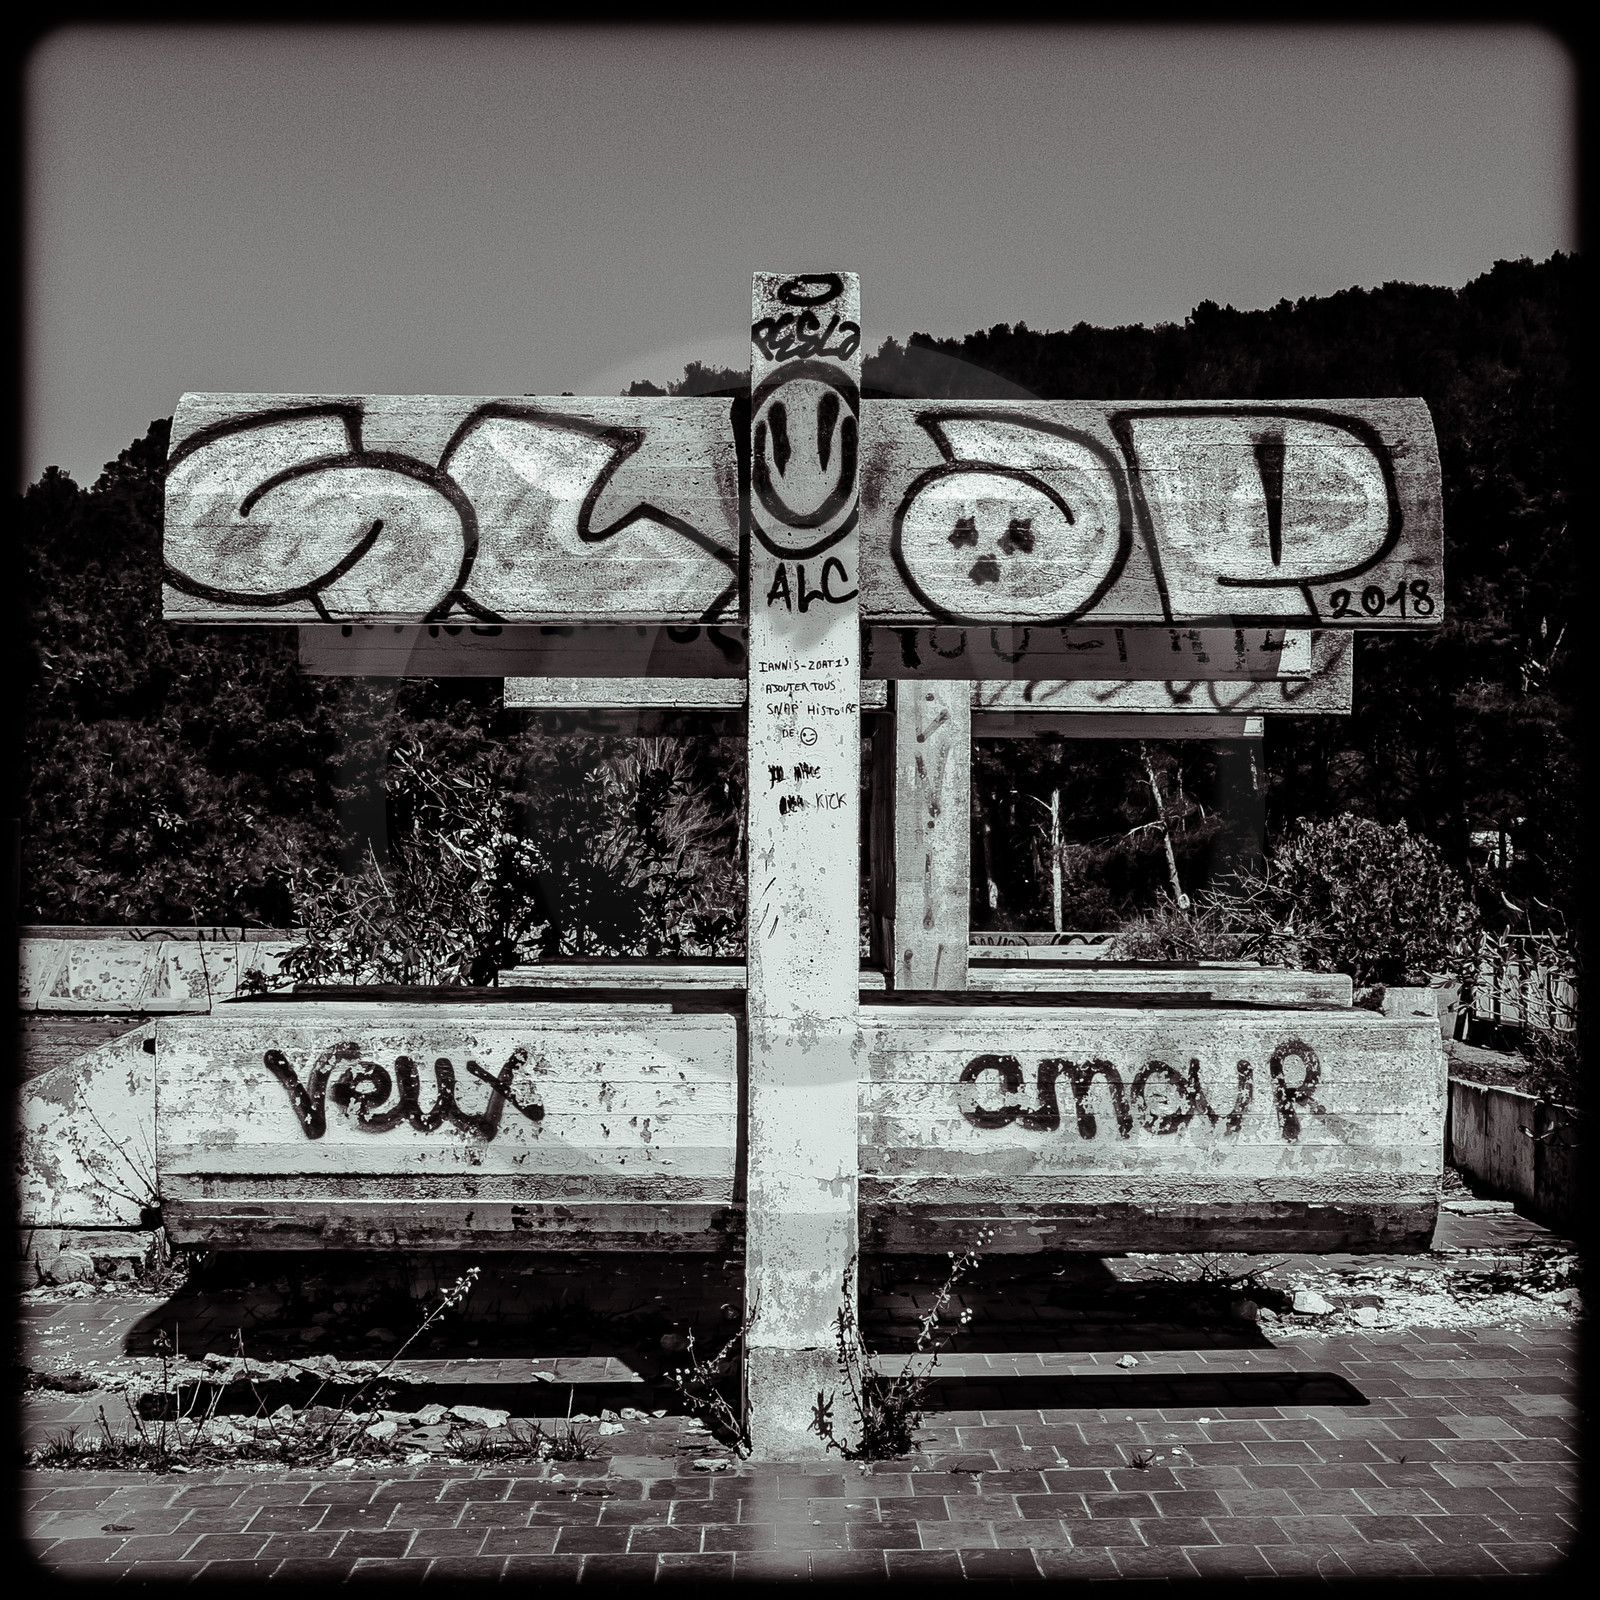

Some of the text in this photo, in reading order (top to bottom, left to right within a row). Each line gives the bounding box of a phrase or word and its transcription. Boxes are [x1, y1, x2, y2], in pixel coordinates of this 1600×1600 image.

[767, 556, 859, 613] ALC
[1329, 579, 1435, 620] 2018
[765, 680, 836, 695] AJOUTER TOUS
[766, 702, 799, 716] SNAP
[782, 728, 795, 738] DE
[815, 791, 848, 814] KICK
